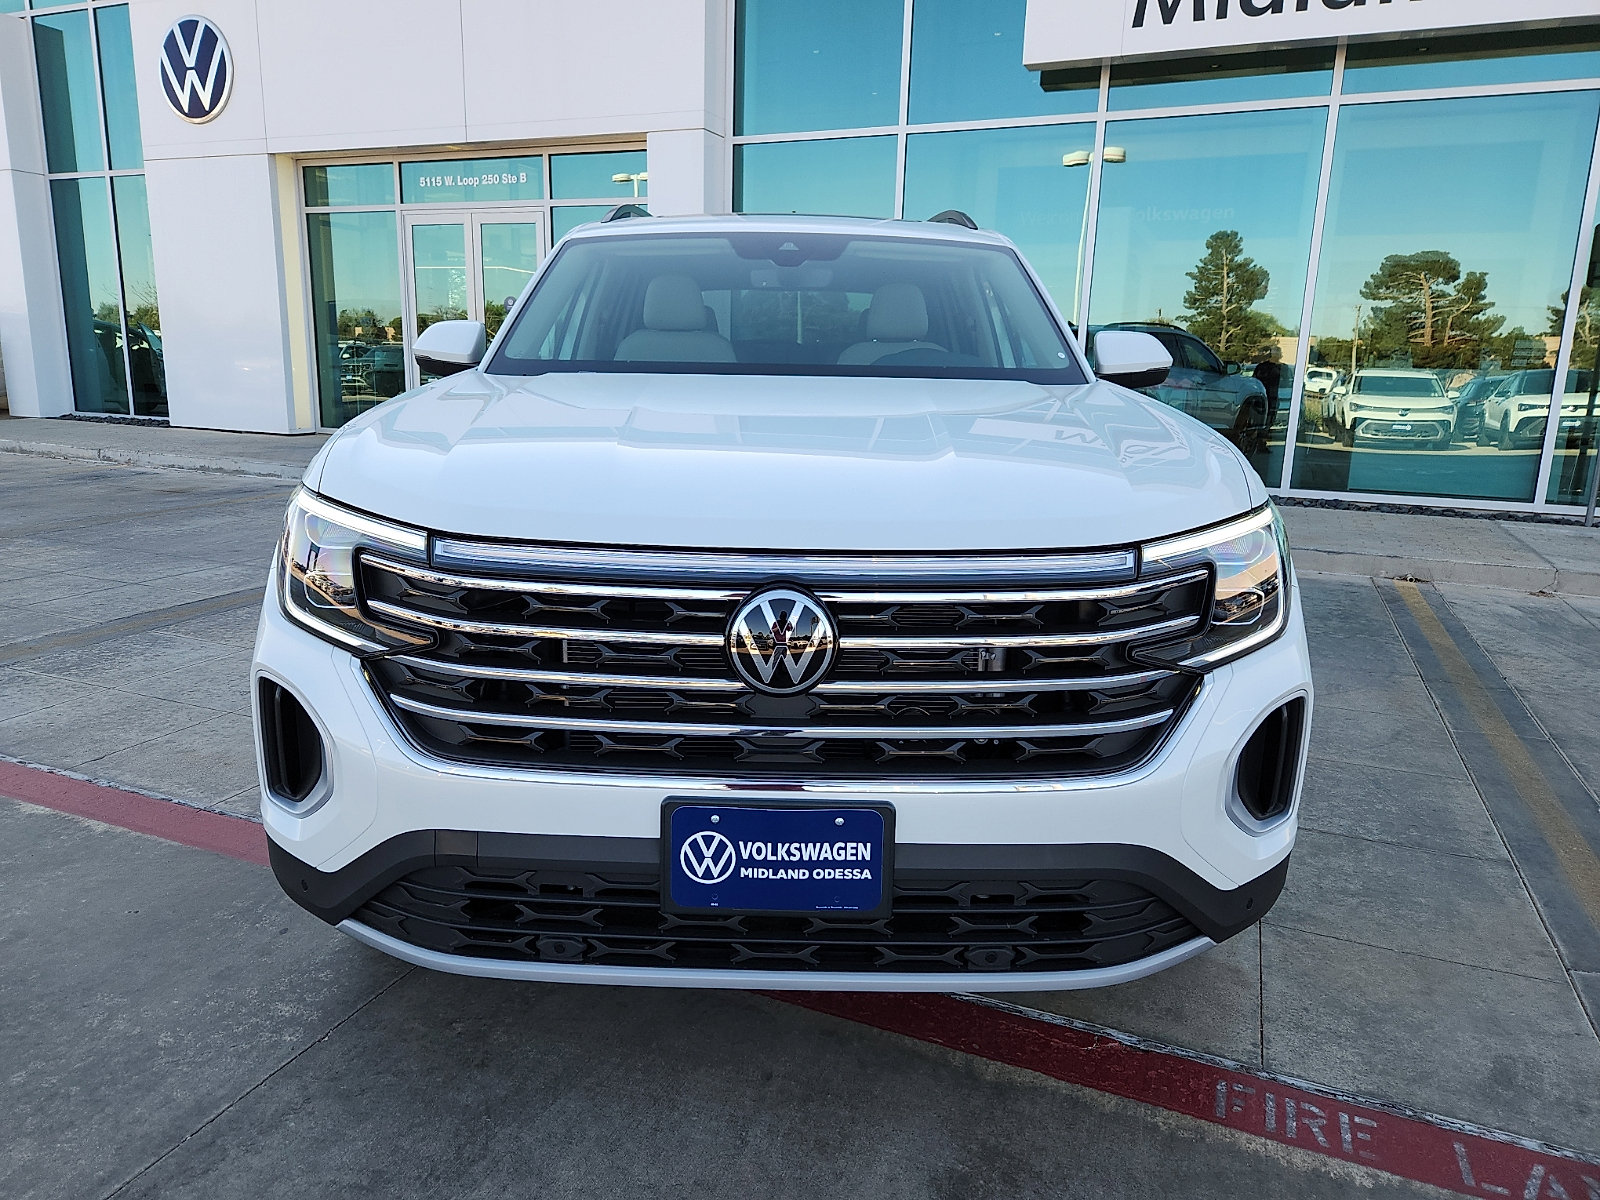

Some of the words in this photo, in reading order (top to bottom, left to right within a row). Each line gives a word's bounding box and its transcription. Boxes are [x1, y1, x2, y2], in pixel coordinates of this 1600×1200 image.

[420, 176, 442, 188] 5115
[444, 176, 456, 186] W.
[457, 175, 480, 188] Loop
[481, 174, 500, 185] 250
[502, 173, 518, 184] Ste
[519, 172, 527, 183] B
[1134, 205, 1236, 224] olkswagen
[738, 841, 872, 861] VOLKSWAGEN
[740, 867, 810, 880] MIDLAND
[812, 868, 873, 880] ODESSA
[1215, 1079, 1378, 1159] FIRE
